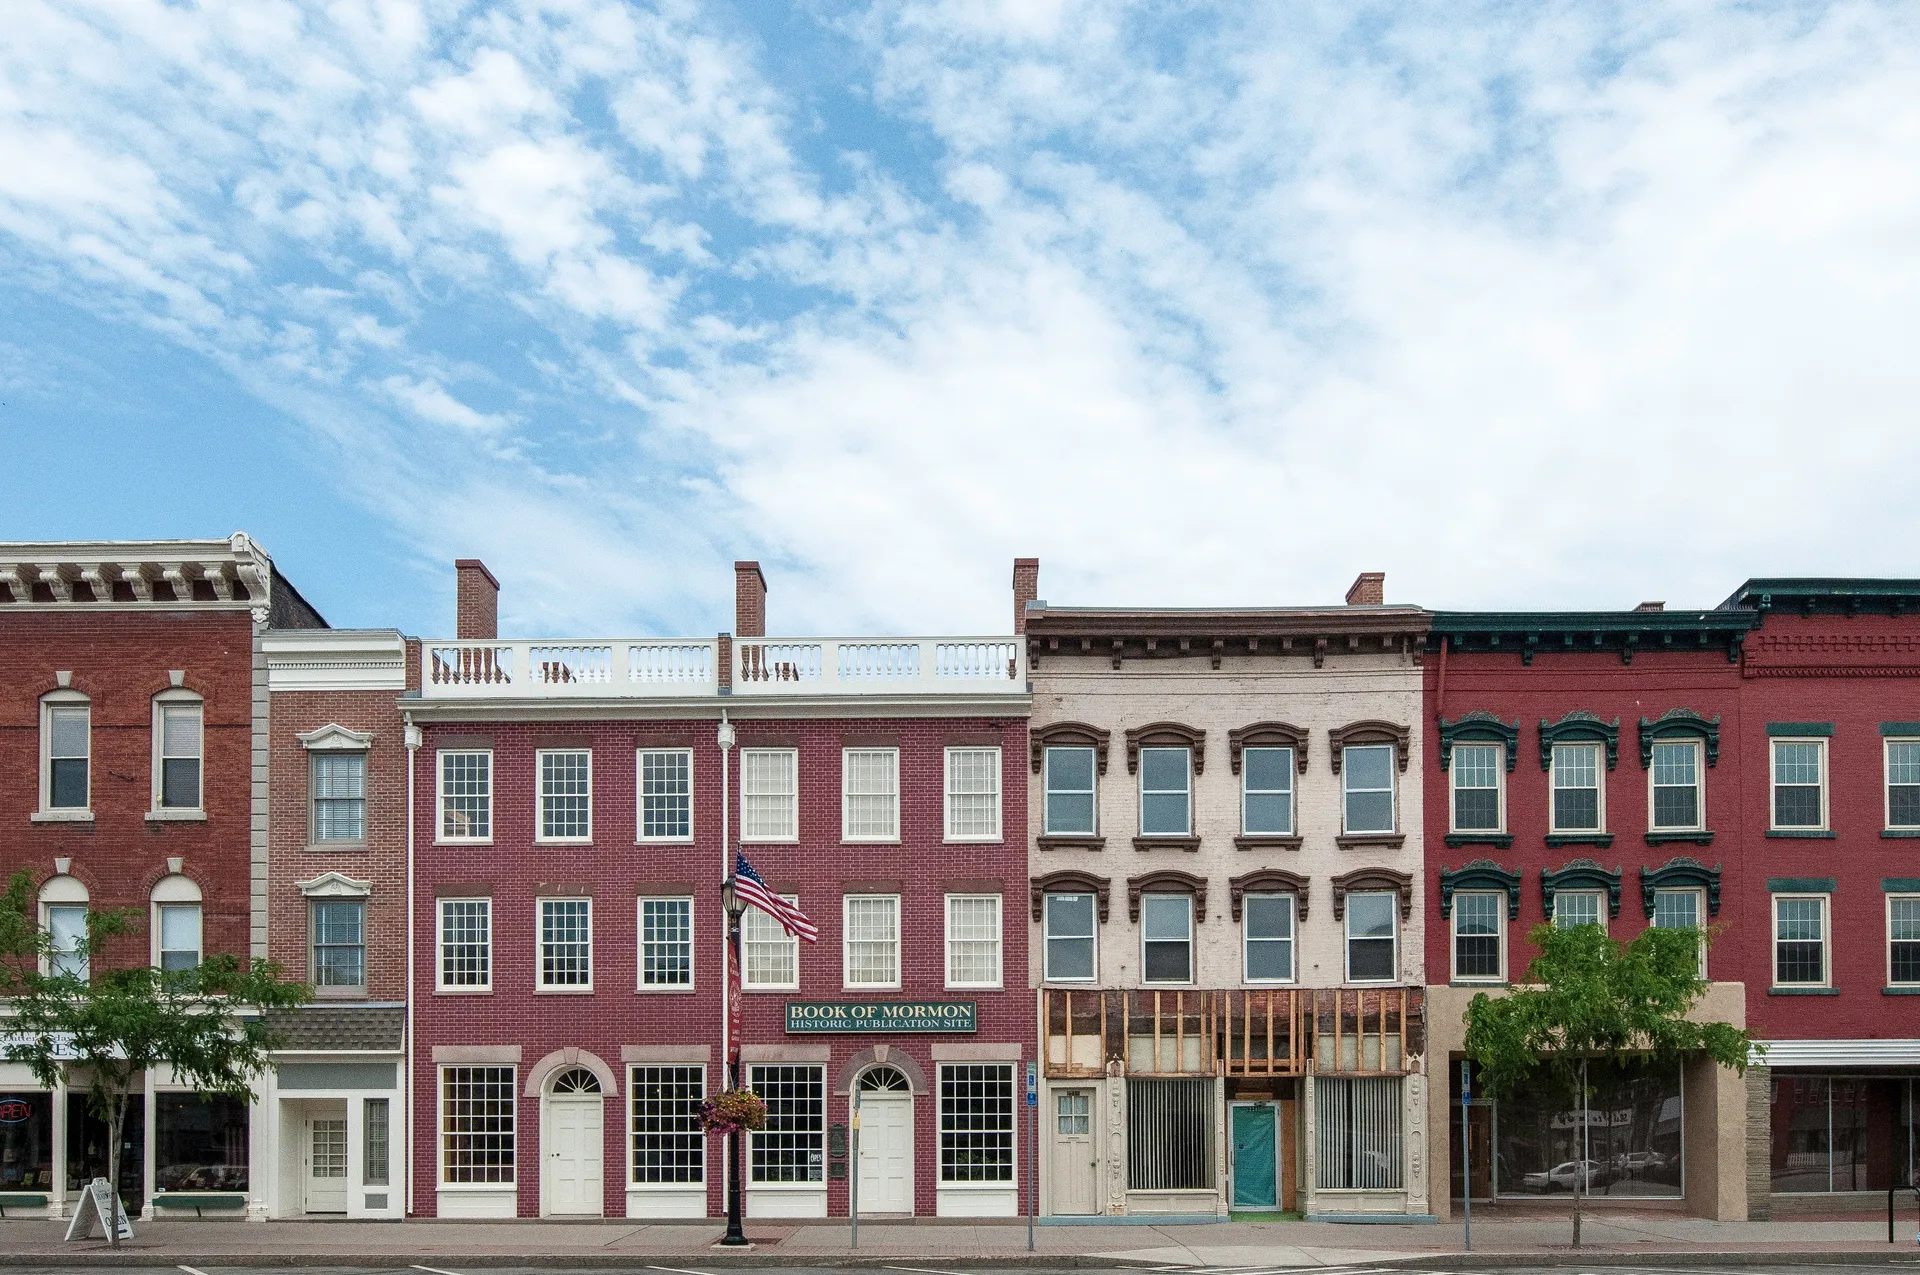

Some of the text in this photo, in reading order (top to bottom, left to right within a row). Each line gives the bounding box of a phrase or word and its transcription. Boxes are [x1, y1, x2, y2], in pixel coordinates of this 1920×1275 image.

[791, 1005, 972, 1018] BOOK OF MORMON
[791, 1019, 972, 1028] HISTORIC PUBLICATION SITE
